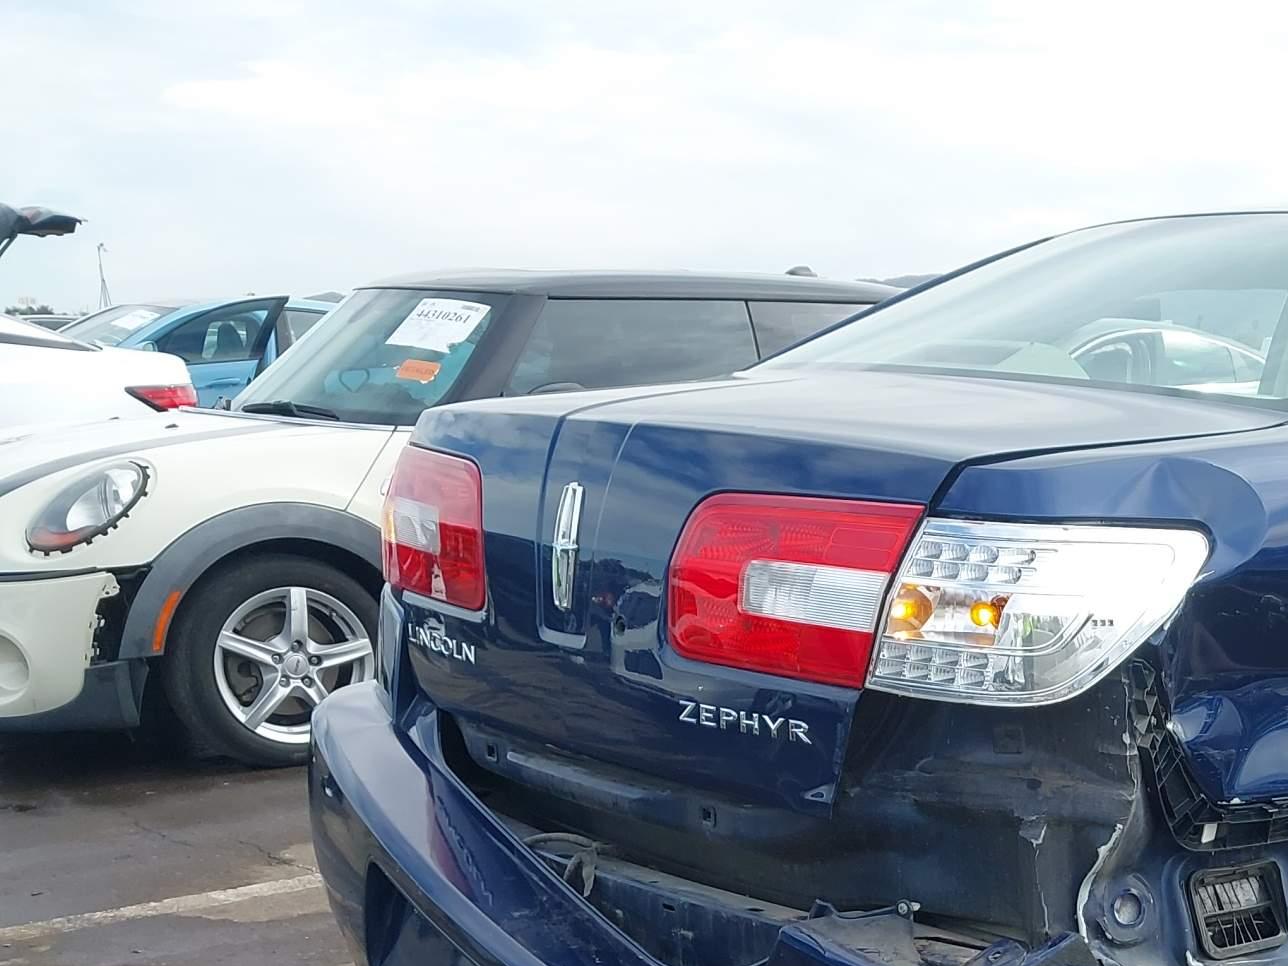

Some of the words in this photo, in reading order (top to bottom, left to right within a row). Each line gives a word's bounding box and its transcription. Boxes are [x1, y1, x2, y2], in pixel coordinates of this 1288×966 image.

[416, 309, 471, 324] 44310261
[408, 622, 476, 665] LINCOLN
[679, 700, 812, 744] ZEPHYR
